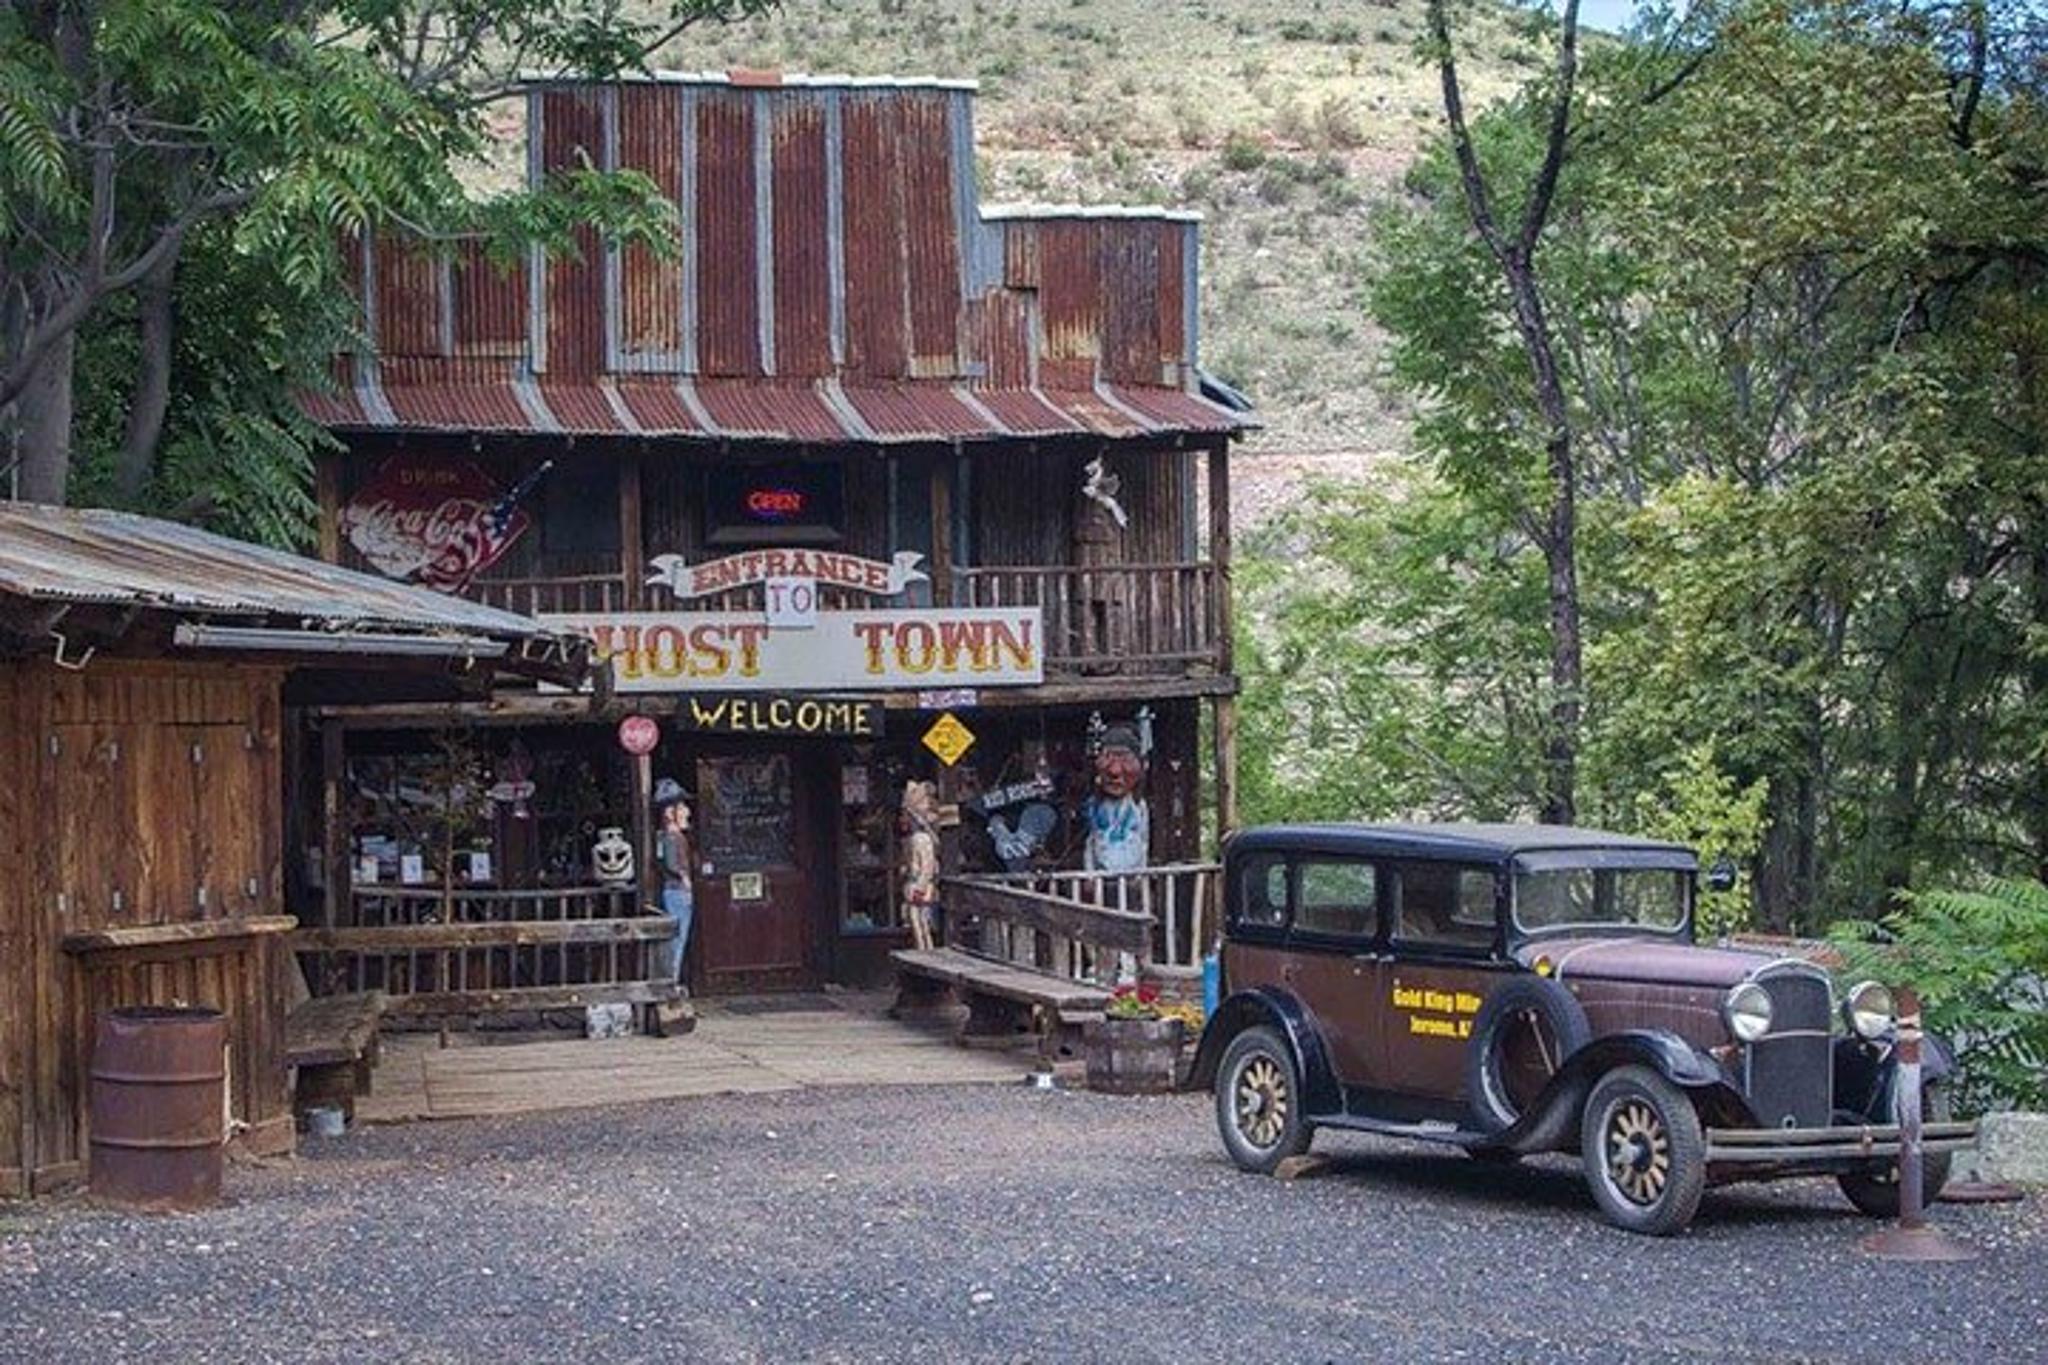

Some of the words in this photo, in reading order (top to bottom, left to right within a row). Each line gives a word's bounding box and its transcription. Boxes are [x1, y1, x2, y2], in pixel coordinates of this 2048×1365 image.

[748, 491, 801, 511] OPEN
[692, 550, 889, 594] ENTRANCE
[769, 584, 812, 614] TO
[590, 622, 769, 680] HOST
[853, 619, 1035, 675] TOWN
[690, 698, 871, 734] WELCOME
[1393, 988, 1422, 1008] Gold
[1425, 991, 1454, 1014] King
[1456, 992, 1482, 1013] Min
